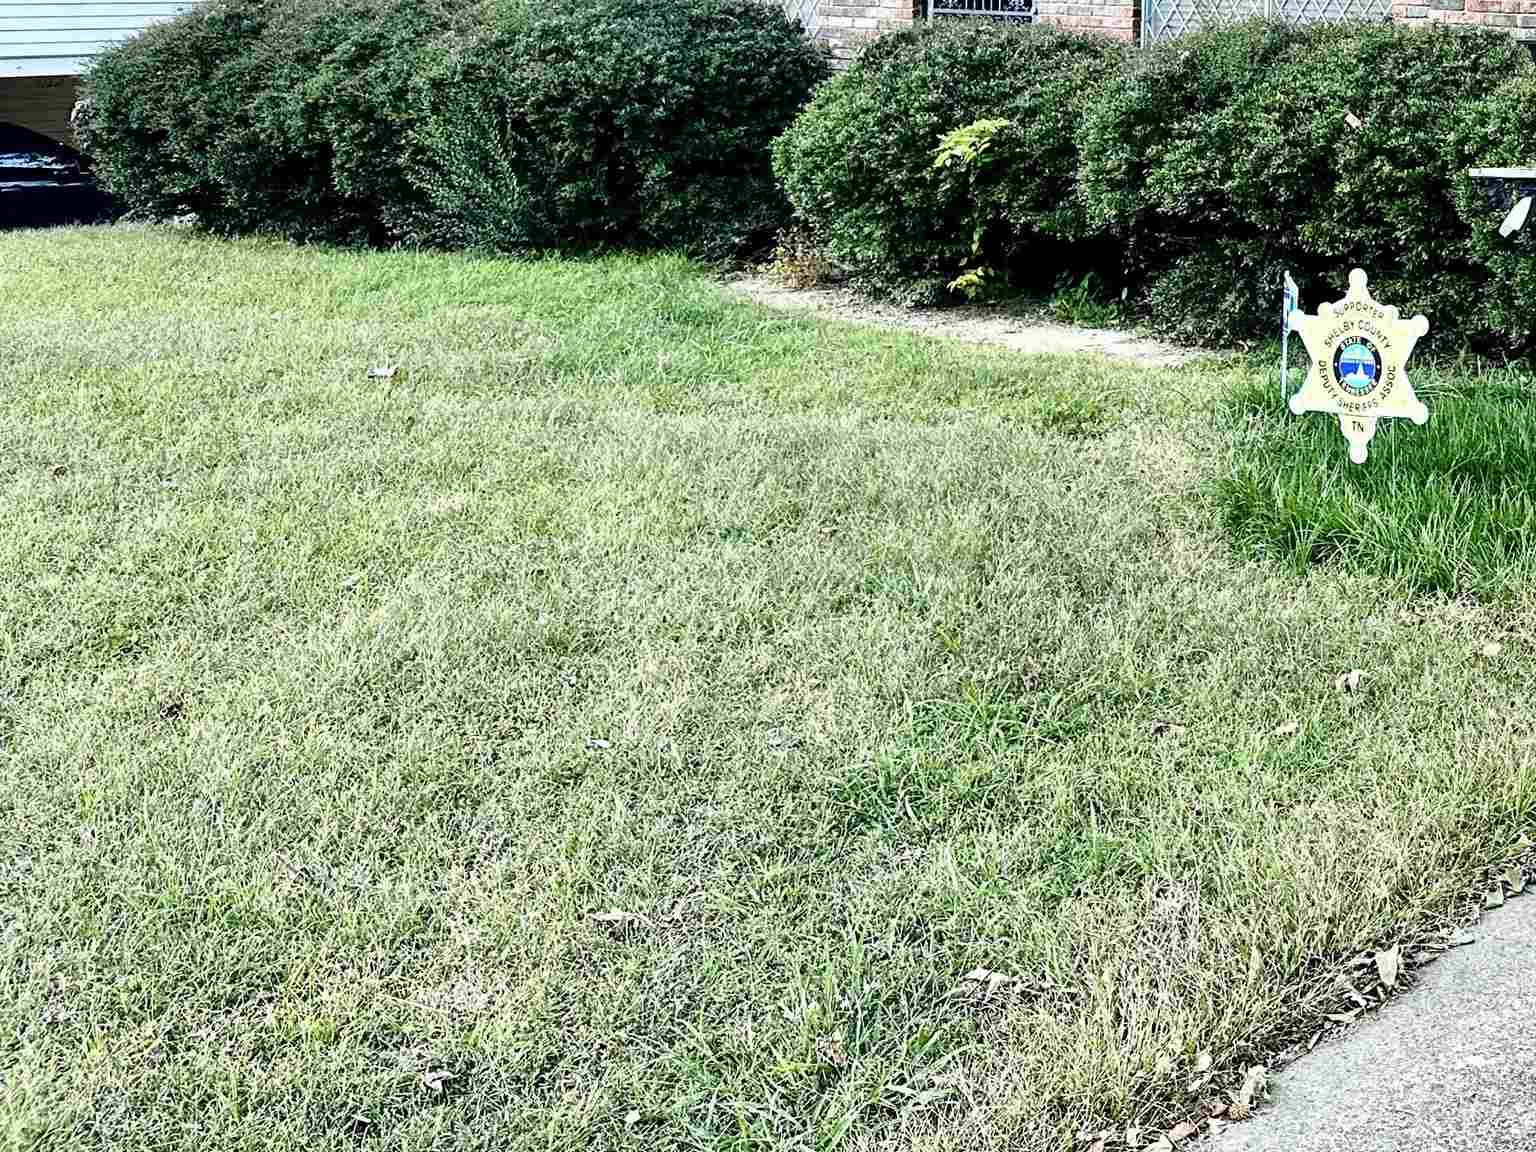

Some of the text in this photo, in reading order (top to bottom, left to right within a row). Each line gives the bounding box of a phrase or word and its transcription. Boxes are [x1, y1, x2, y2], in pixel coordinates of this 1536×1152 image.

[1332, 301, 1385, 319] SUPPORTER
[1324, 319, 1392, 348] SHELBY COUNTY
[1318, 360, 1339, 399] DEPUTY
[1351, 420, 1365, 433] TN
